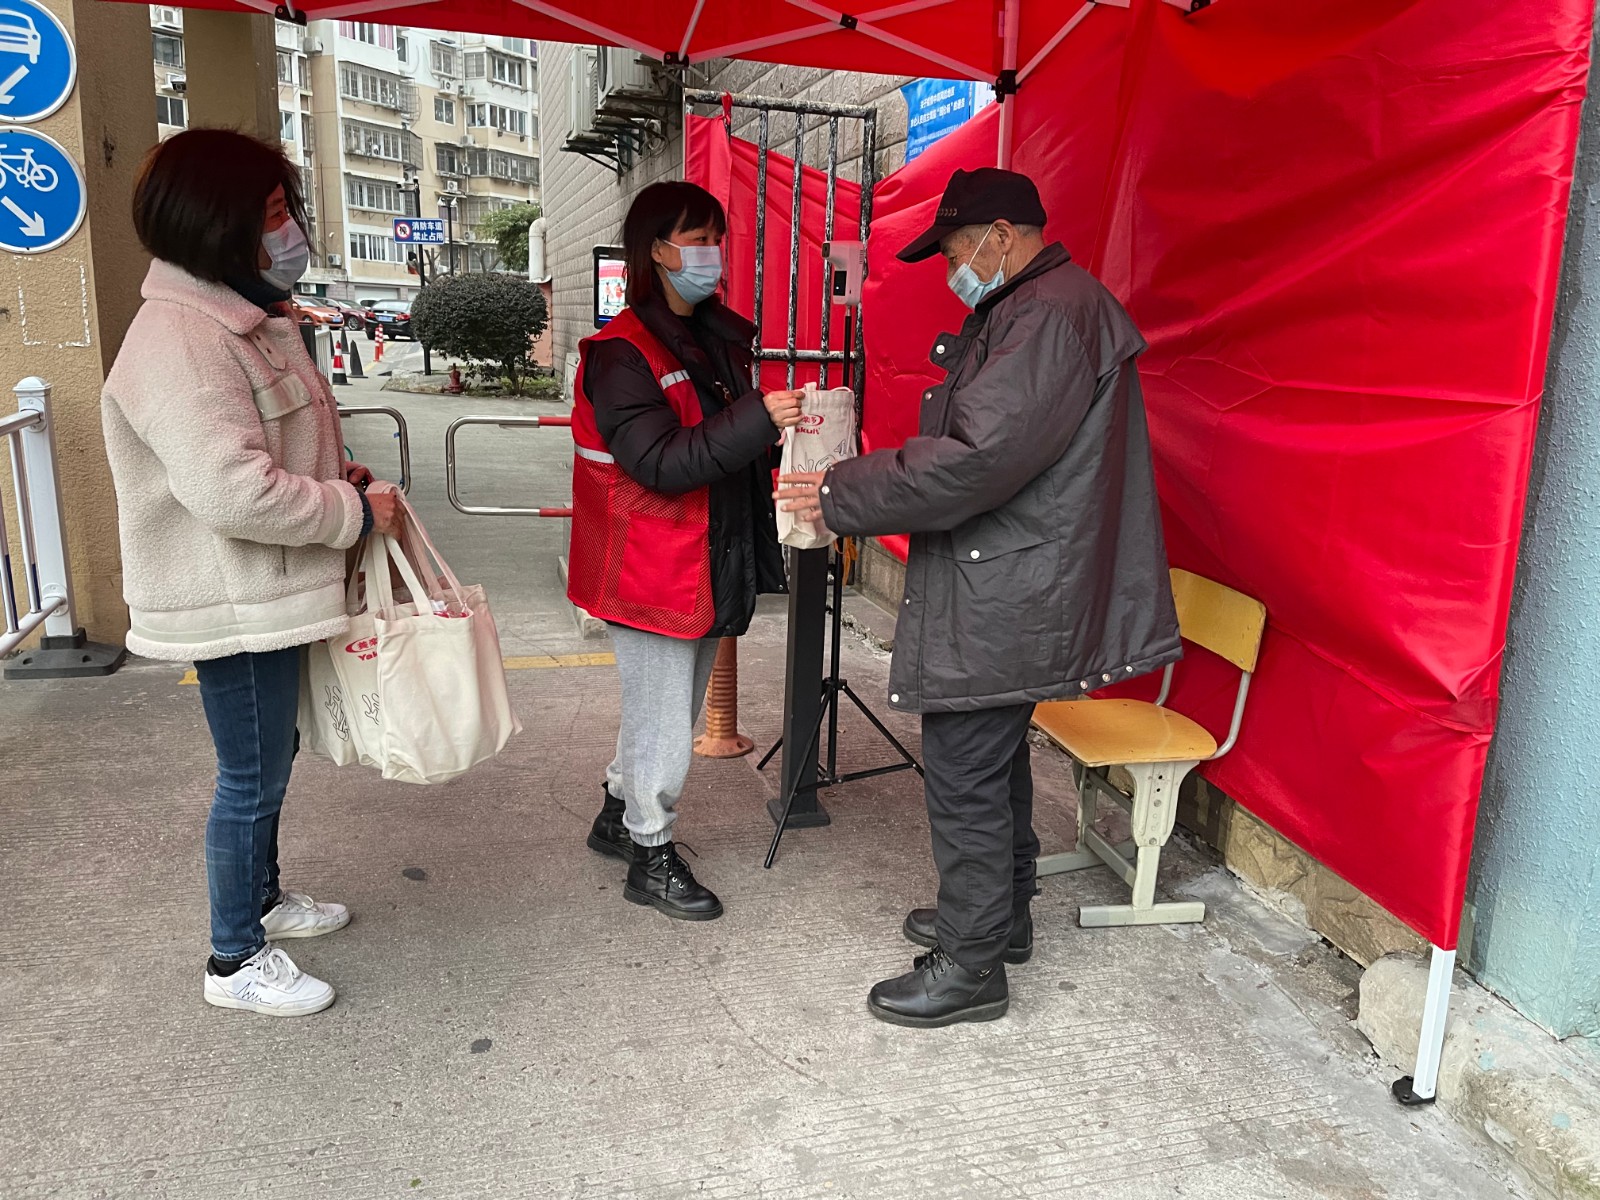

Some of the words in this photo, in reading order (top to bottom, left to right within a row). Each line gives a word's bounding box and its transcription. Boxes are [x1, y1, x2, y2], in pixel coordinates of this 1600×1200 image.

[412, 221, 442, 231] 消防车道
[413, 232, 443, 241] 禁止占用
